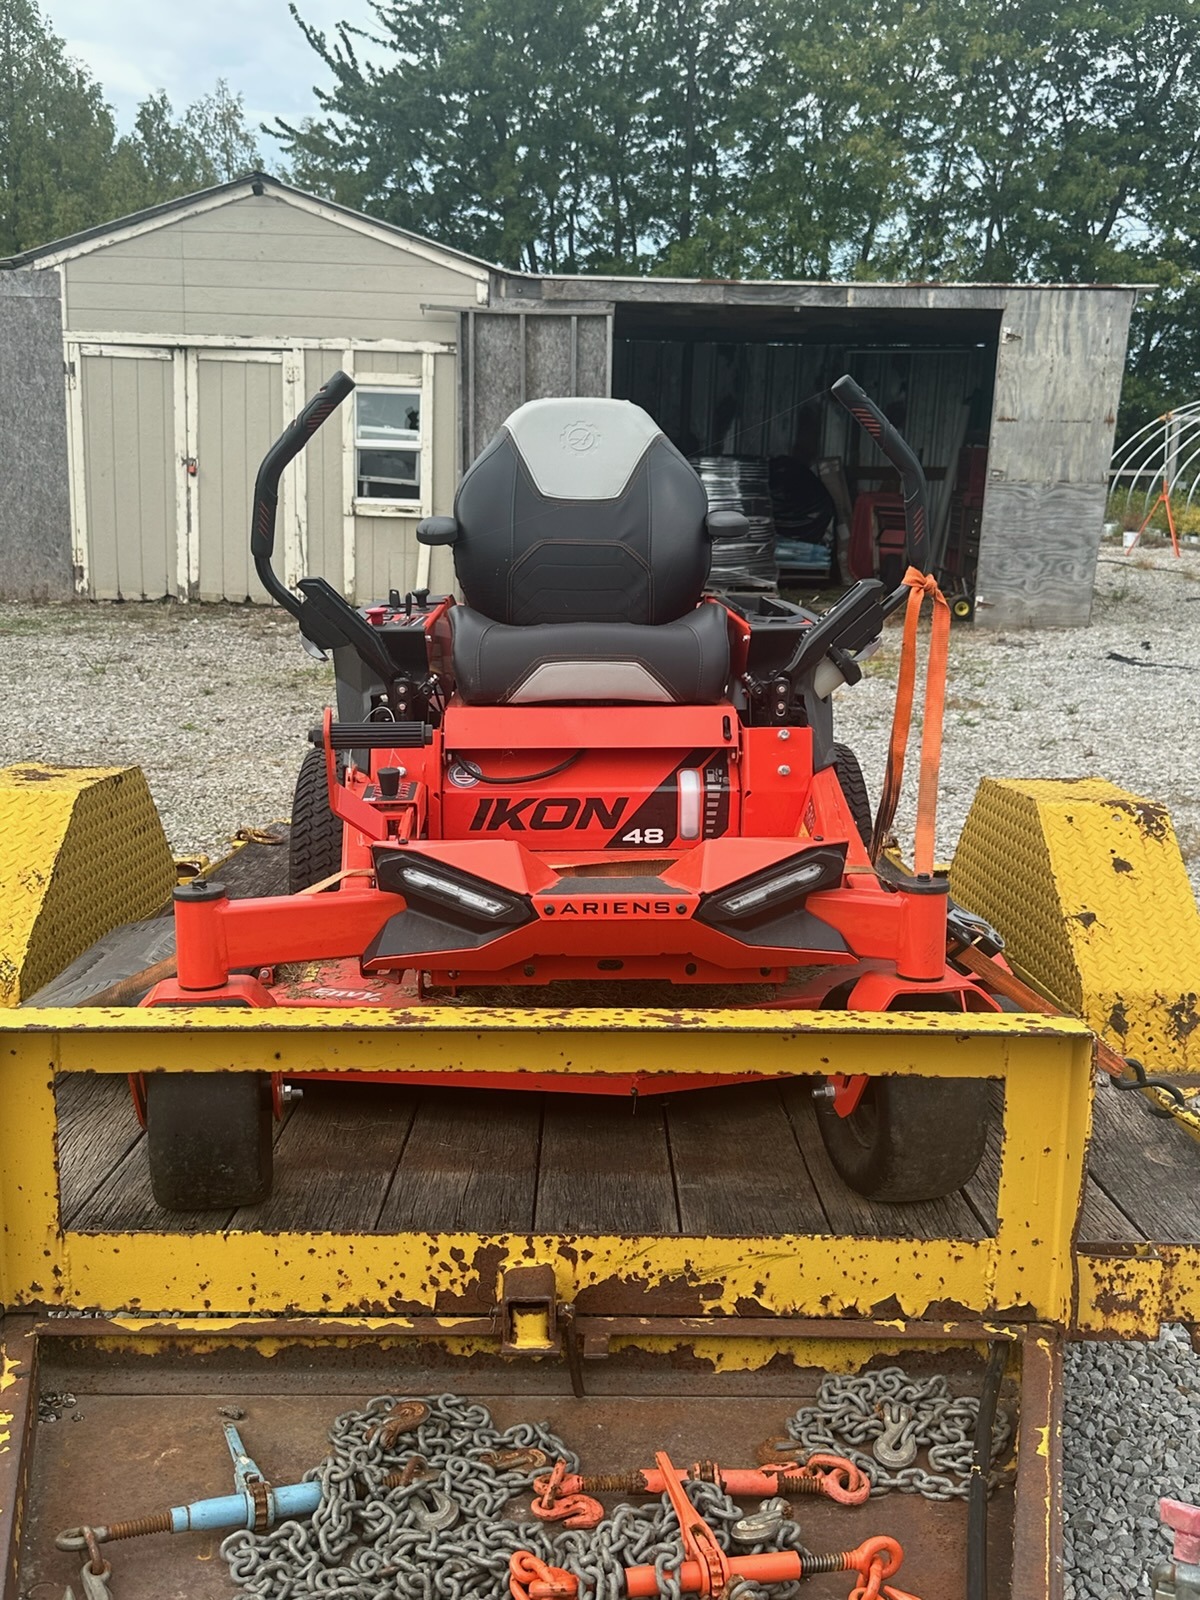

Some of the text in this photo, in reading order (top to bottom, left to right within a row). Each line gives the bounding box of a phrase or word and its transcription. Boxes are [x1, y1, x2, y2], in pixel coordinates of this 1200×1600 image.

[468, 797, 630, 832] IKON
[622, 828, 665, 844] 48
[560, 902, 671, 915] ARIENS
